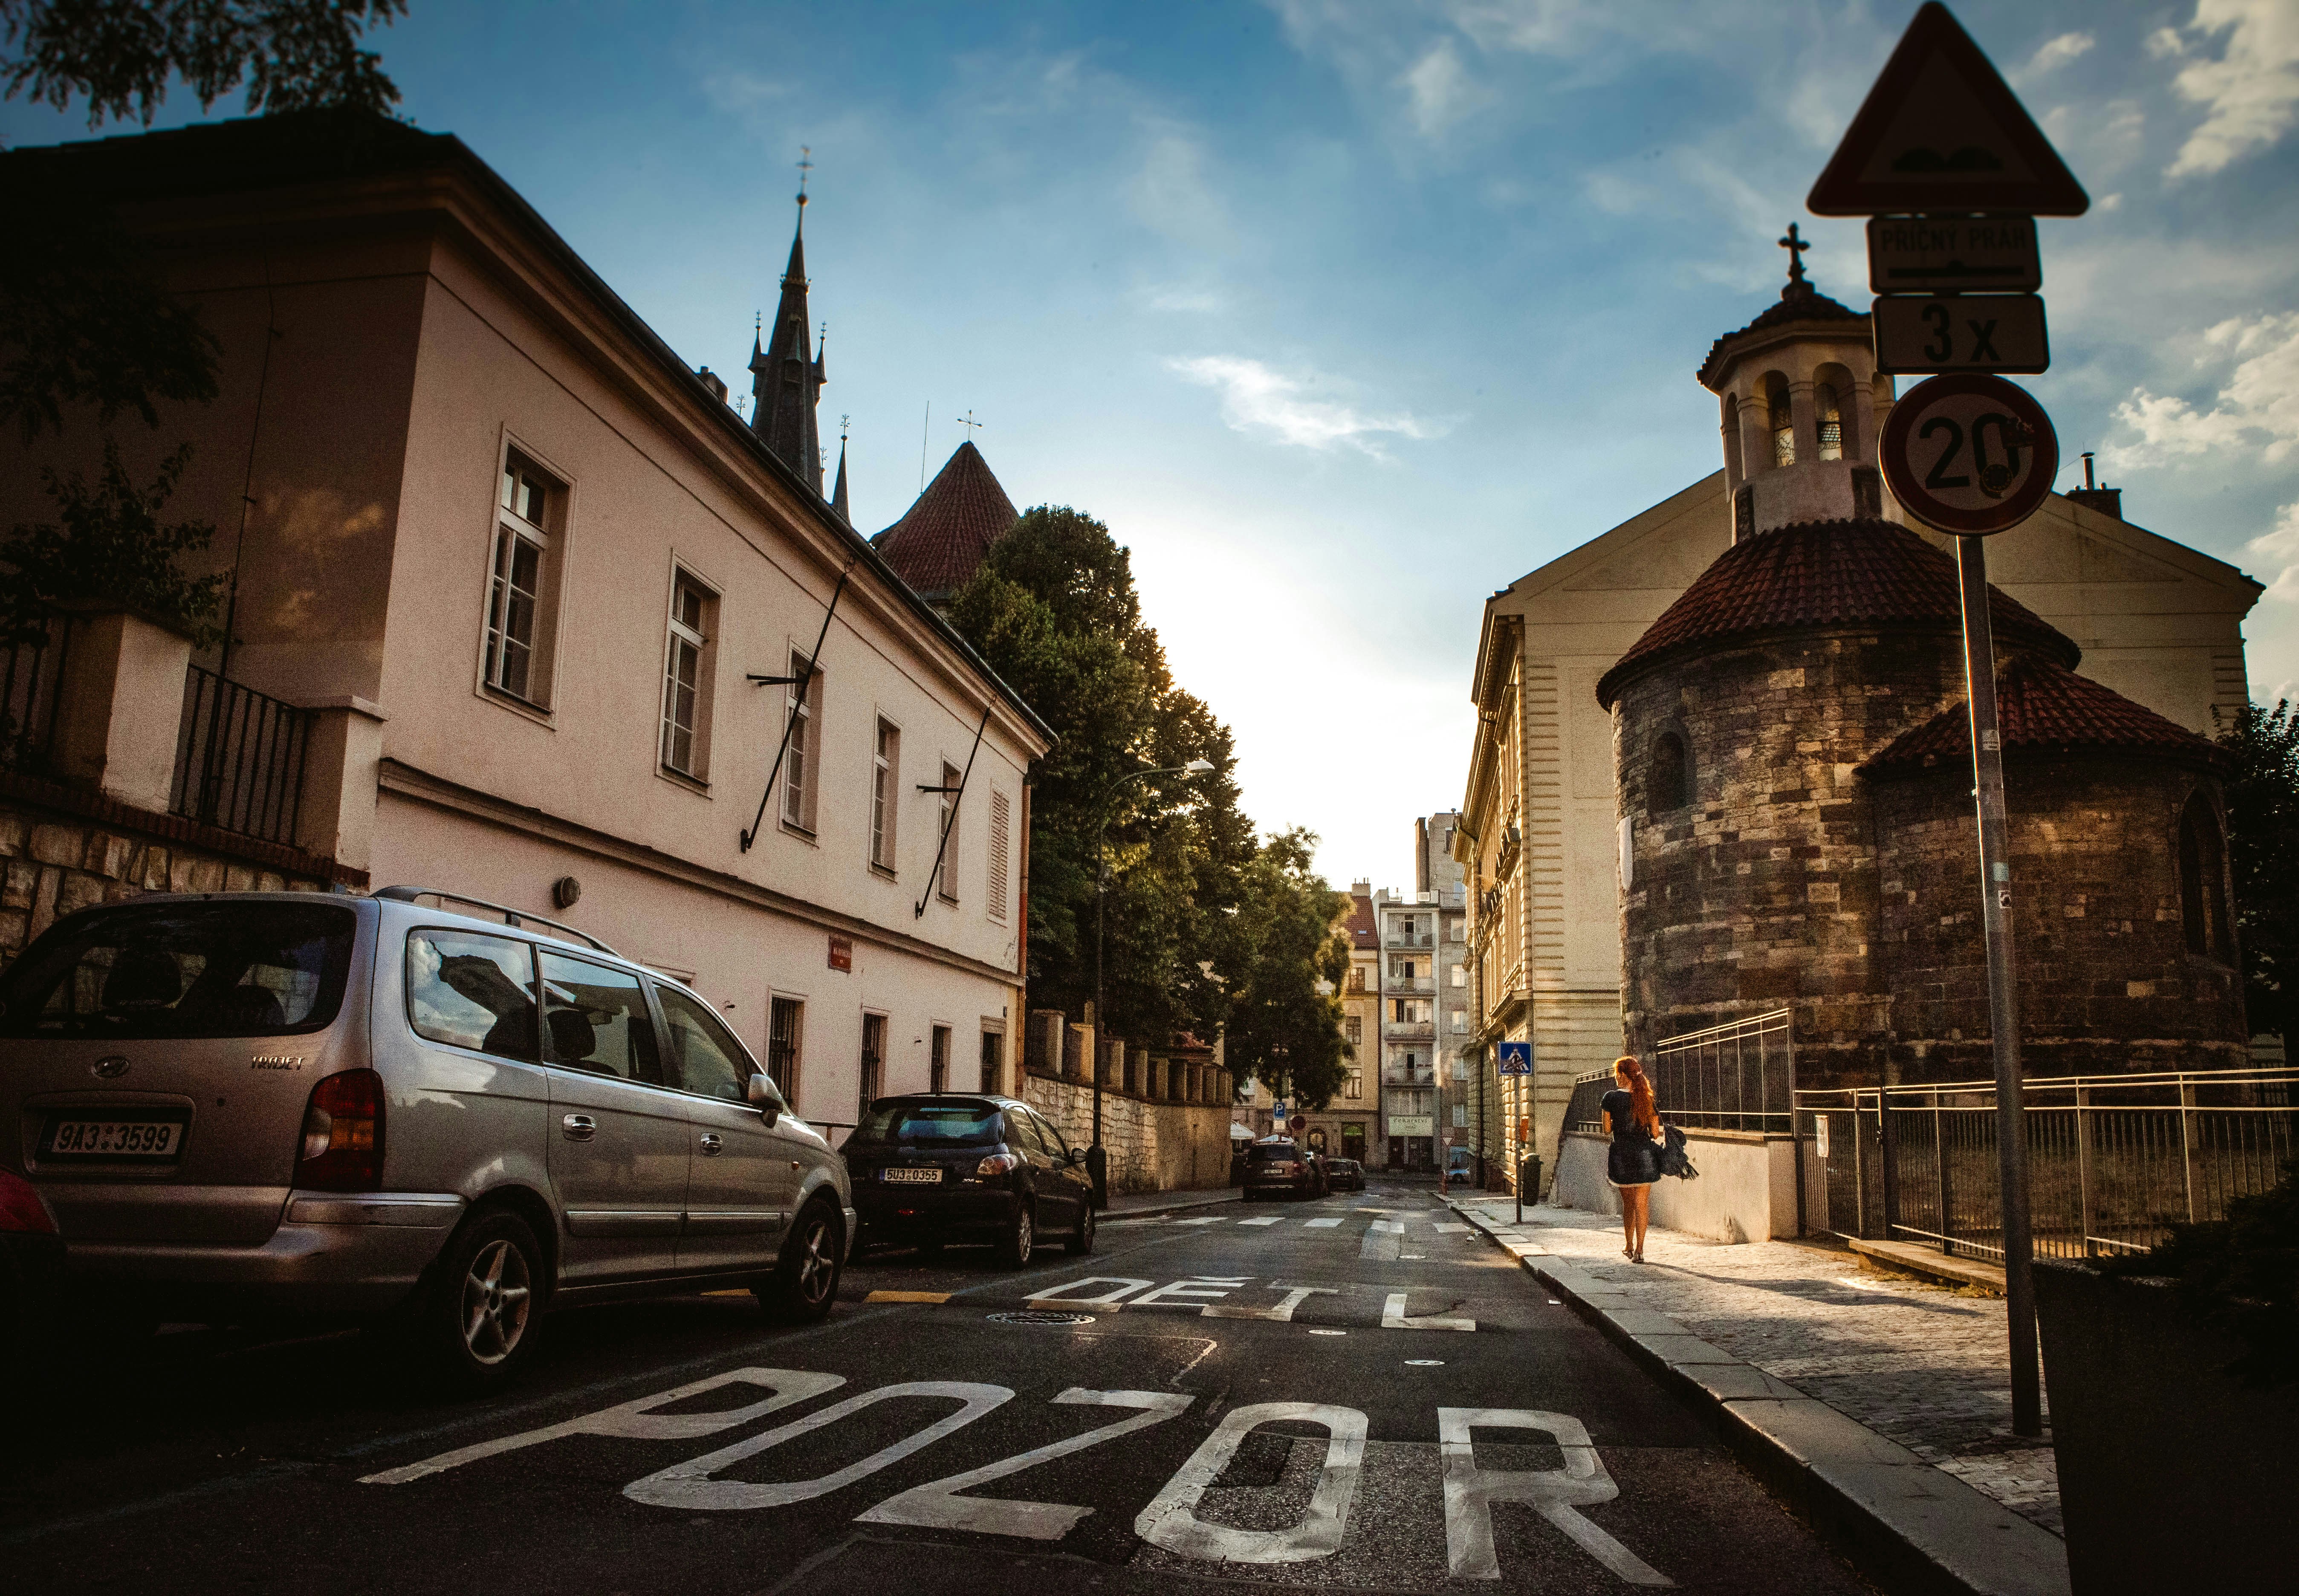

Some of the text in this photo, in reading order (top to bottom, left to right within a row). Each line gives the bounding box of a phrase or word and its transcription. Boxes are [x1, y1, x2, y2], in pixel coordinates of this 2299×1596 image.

[1883, 223, 2026, 251] PŘÍČNÝ PRÁH
[1921, 304, 1952, 362] 3
[1919, 413, 2020, 498] 20
[251, 1056, 305, 1070] TRAJET
[1276, 1104, 1283, 1114] P
[58, 1125, 171, 1151] 9A3 3599
[355, 1367, 1680, 1584] POZOR
